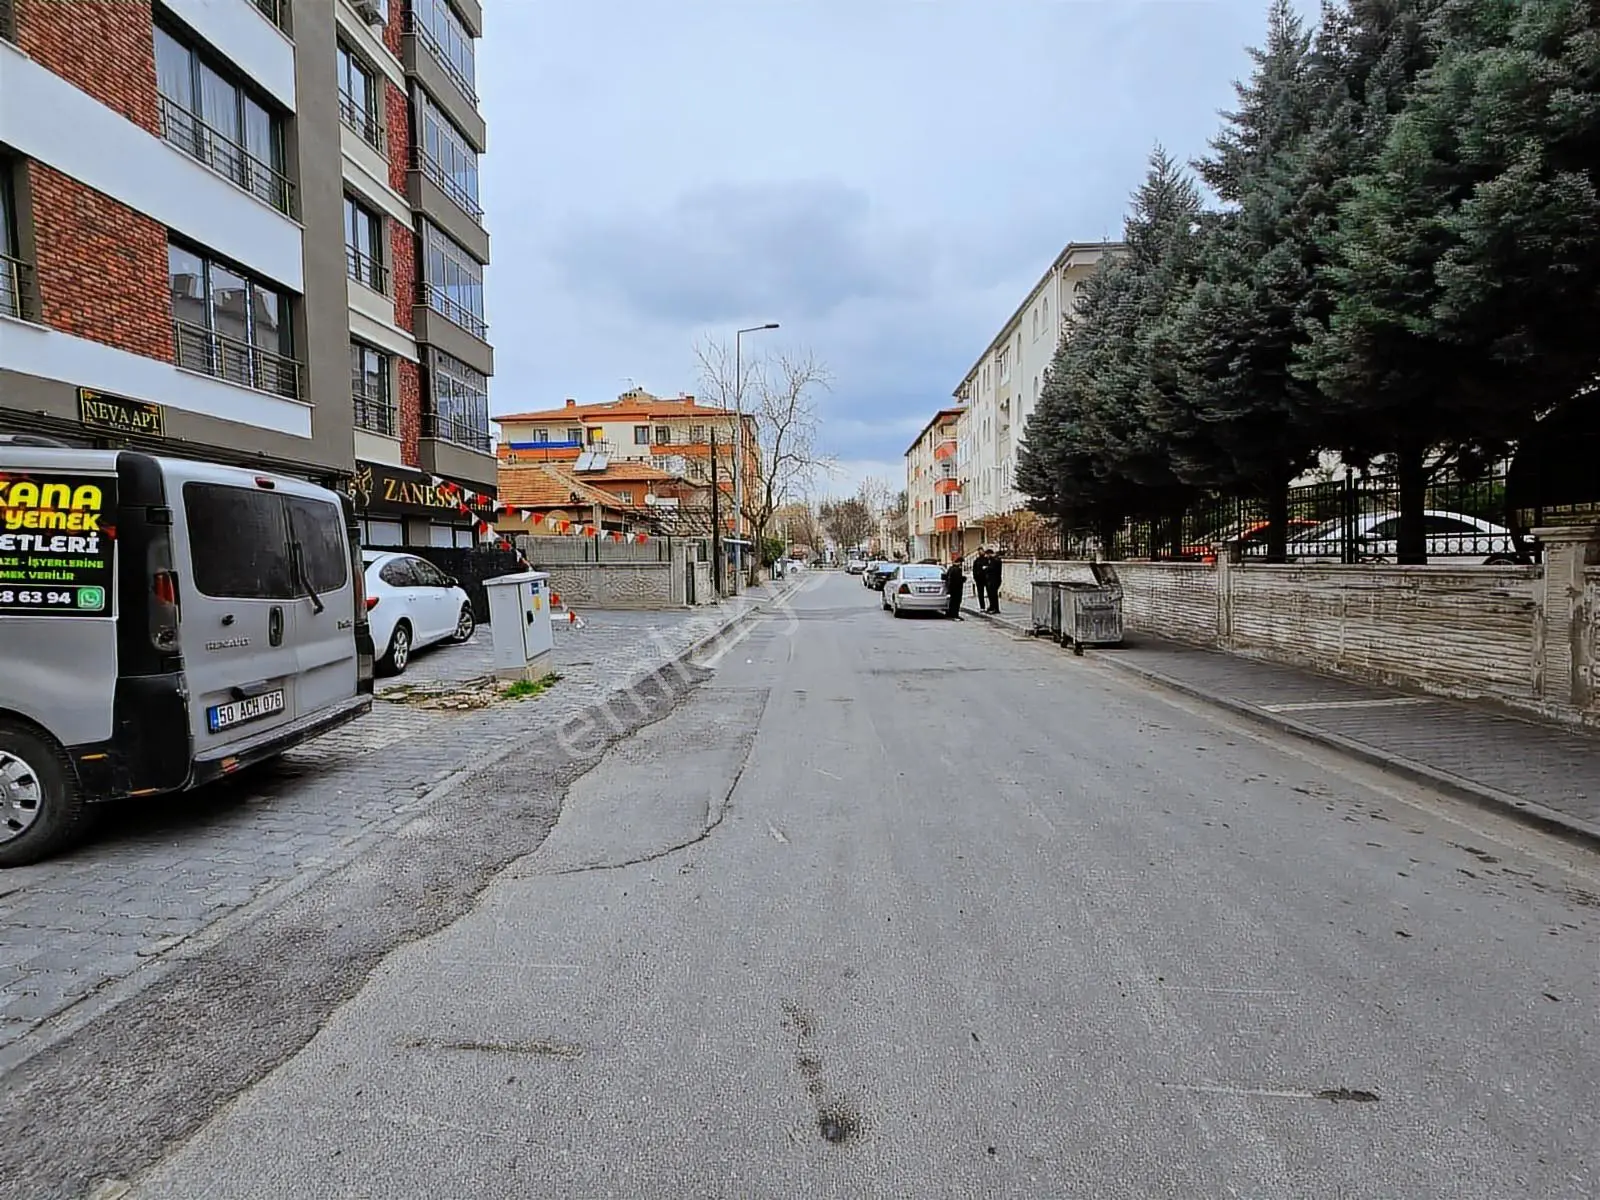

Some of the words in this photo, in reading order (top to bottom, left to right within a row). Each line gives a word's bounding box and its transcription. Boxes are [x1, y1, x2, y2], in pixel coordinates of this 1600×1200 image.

[85, 401, 130, 424] NEVA
[132, 410, 159, 429] APT
[5, 510, 102, 531] YEMEK
[0, 532, 99, 553] ETLERİ
[0, 590, 14, 603] 8
[18, 591, 42, 604] 63
[47, 591, 71, 604] 94
[219, 705, 234, 724] 50
[240, 698, 260, 718] ACH
[263, 692, 281, 711] 076
